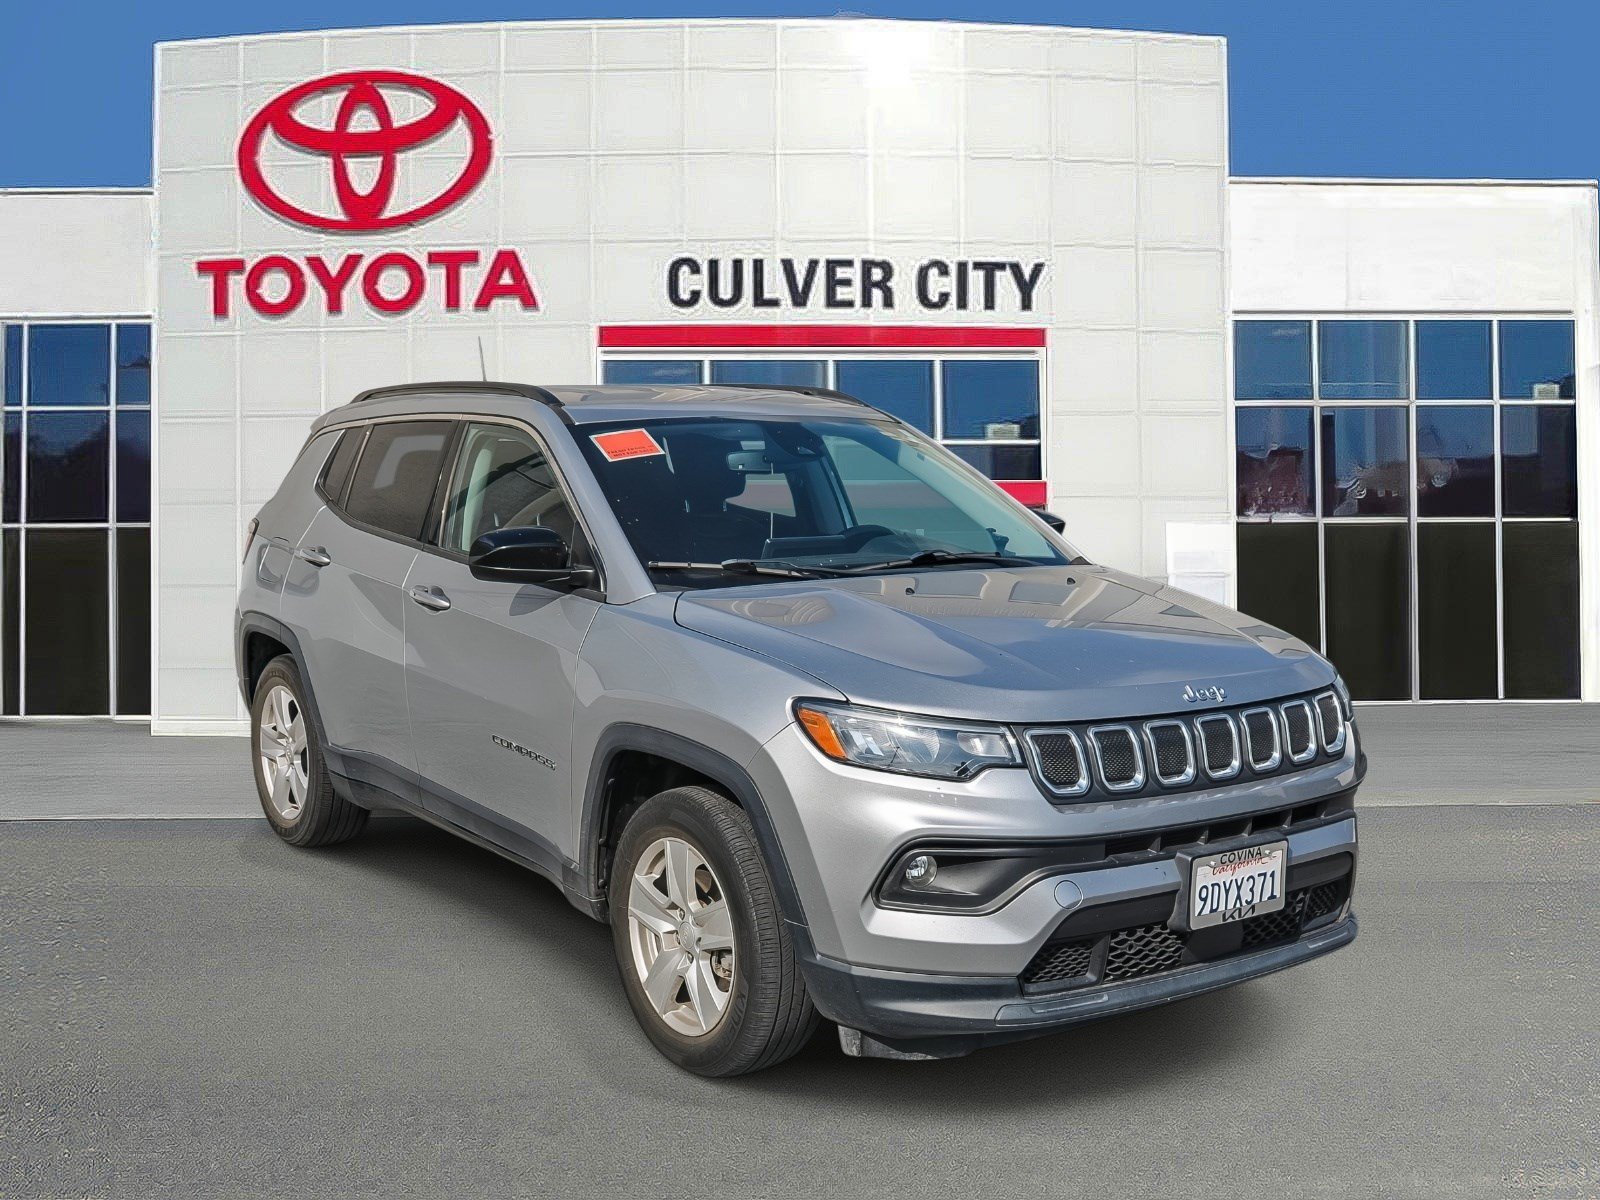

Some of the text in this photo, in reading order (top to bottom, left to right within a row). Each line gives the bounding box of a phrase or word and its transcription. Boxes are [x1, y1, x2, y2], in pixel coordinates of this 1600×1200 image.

[196, 250, 540, 318] TOYOTA
[667, 257, 1046, 311] CULVER CITY
[1182, 684, 1228, 703] Jeep
[492, 734, 556, 771] COMPASS
[1220, 847, 1262, 864] COVINA
[1198, 870, 1277, 916] 9DYX371
[1222, 904, 1256, 922] KIA
